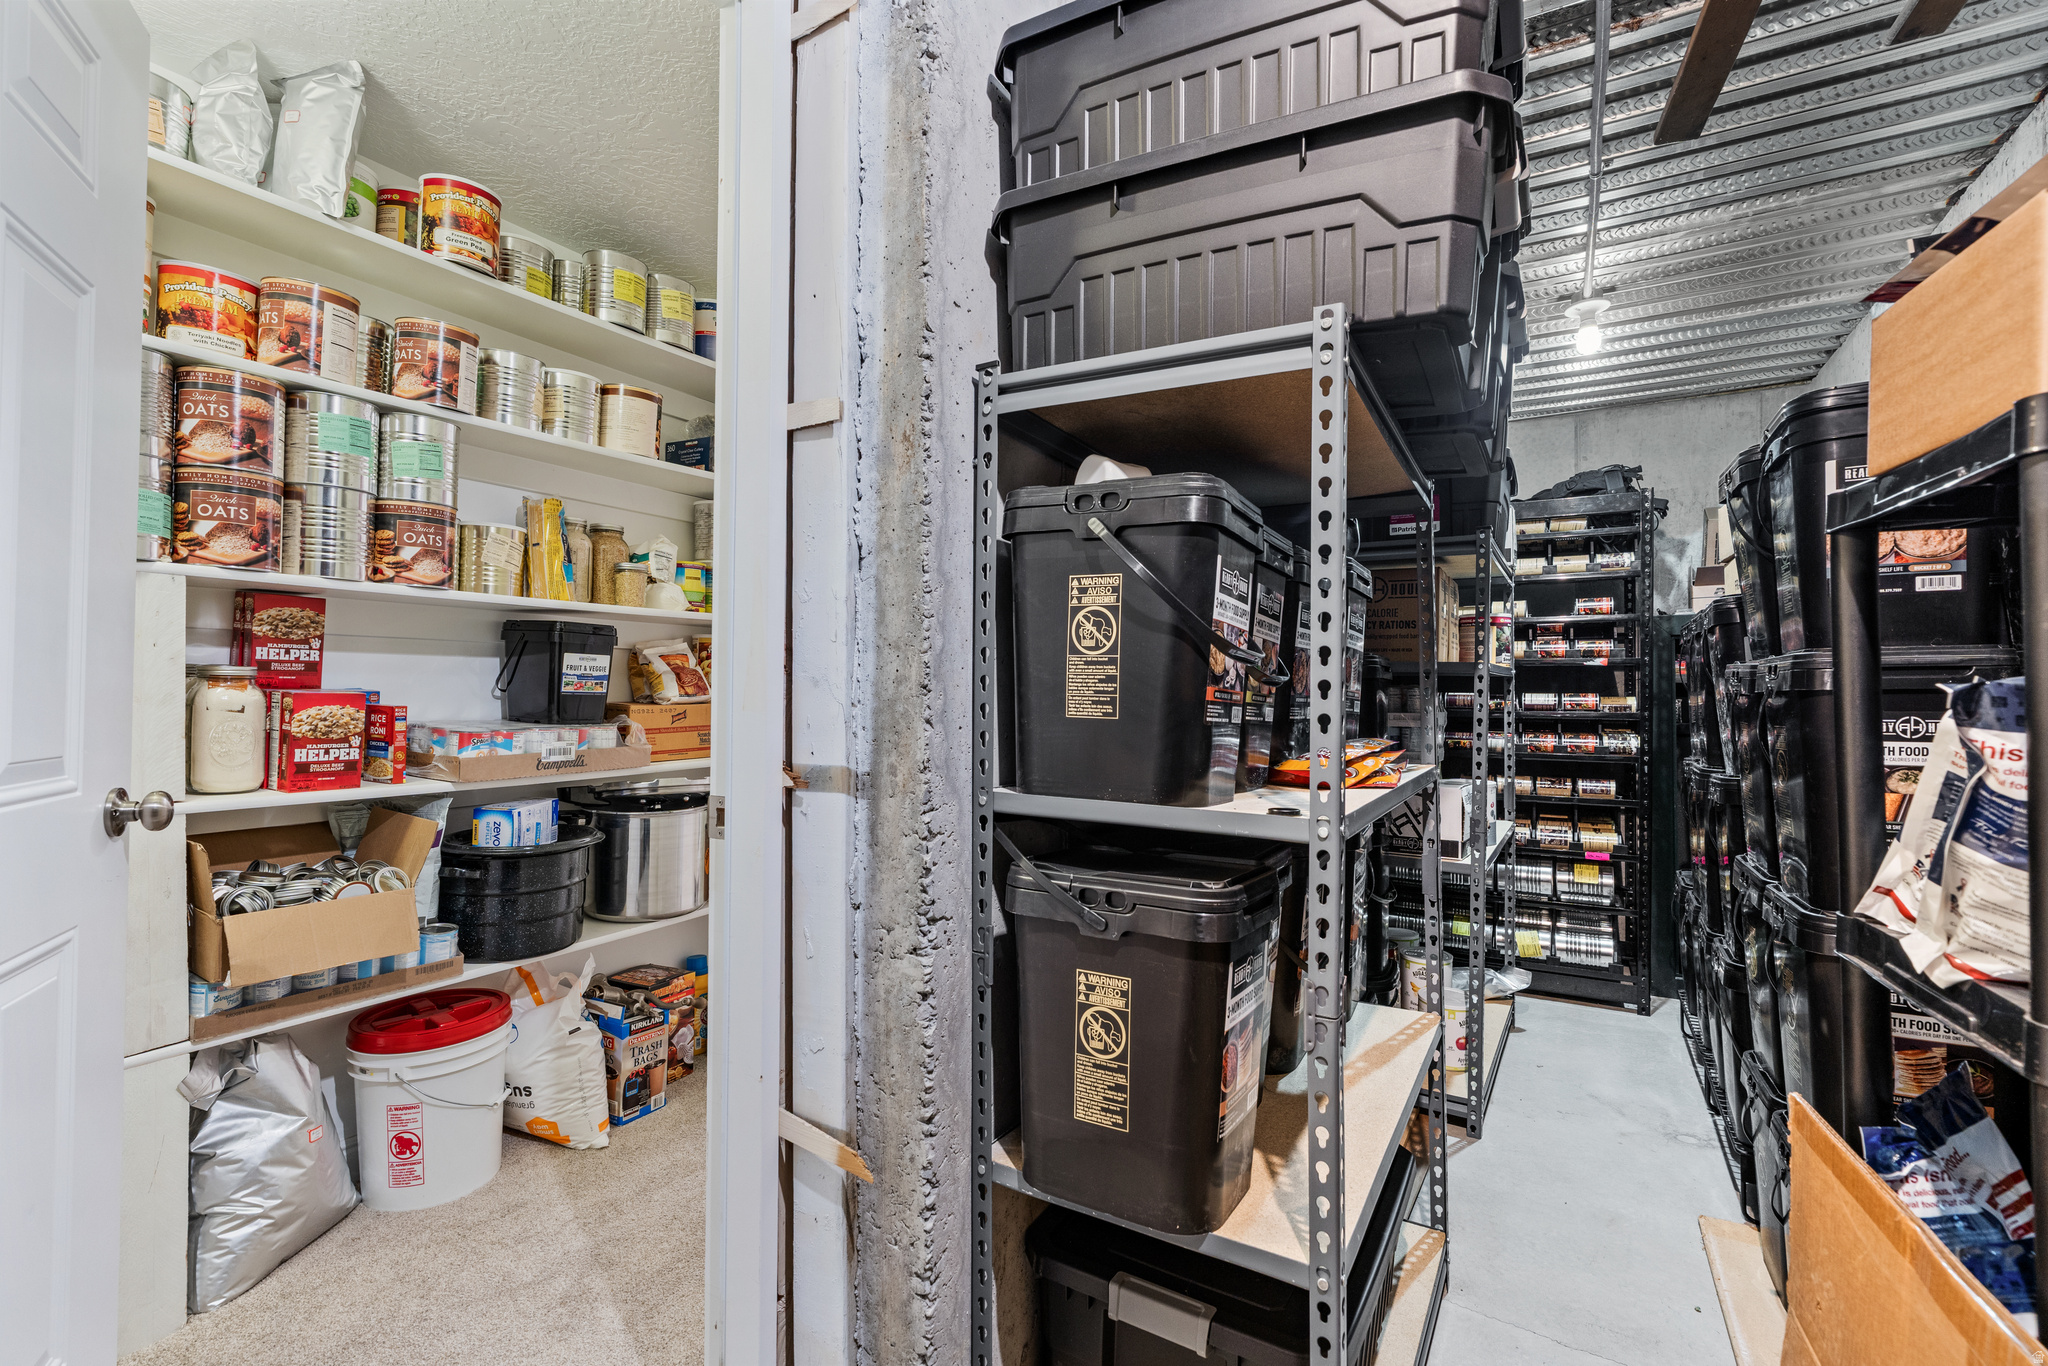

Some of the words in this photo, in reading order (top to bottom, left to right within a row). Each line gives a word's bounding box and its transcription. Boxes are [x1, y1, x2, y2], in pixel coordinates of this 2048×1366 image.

[430, 191, 475, 205] Provident
[476, 195, 498, 222] Pantry
[442, 201, 490, 225] PREMIUM
[446, 236, 468, 247] Green
[470, 242, 486, 253] Peas
[272, 282, 307, 291] STORAGE
[164, 281, 217, 295] Provident
[218, 288, 253, 312] Pantry
[176, 293, 238, 316] PREMIUM
[261, 302, 271, 310] uick
[260, 311, 279, 324] ATS
[187, 331, 215, 341] Teriyaki
[217, 337, 242, 348] Noodles
[397, 339, 414, 347] Quick
[210, 341, 237, 351] Chicken
[394, 348, 422, 360] OATS
[190, 391, 217, 401] Quick
[182, 402, 230, 418] OATS
[666, 444, 676, 453] 360
[1844, 467, 1868, 479] REA
[239, 477, 274, 488] STORAGE
[206, 493, 238, 504] Quick
[197, 503, 249, 521] OATS
[410, 524, 435, 533] Quick
[1398, 525, 1417, 533] Patrio
[403, 532, 443, 547] OATS
[1080, 576, 1120, 585] WARNING
[1087, 586, 1112, 595] AVISO
[1391, 582, 1418, 595] HOU
[1366, 607, 1399, 618] CALORIE
[1378, 620, 1417, 630] RATIONS
[255, 646, 320, 661] HELPER
[370, 713, 386, 723] RICE
[369, 726, 386, 735] RONI
[293, 747, 360, 762] HELPER
[1899, 746, 1930, 757] FOOD
[492, 821, 501, 847] zevo
[1087, 973, 1129, 989] WARNING
[1094, 985, 1121, 998] AVISO
[630, 1014, 664, 1031] KIRKLAND
[1909, 1019, 1941, 1033] FOOD
[628, 1027, 666, 1046] DRAWSTRING
[1899, 1029, 1922, 1037] CALORIES
[629, 1039, 663, 1059] TRASH
[633, 1051, 659, 1067] BAGS
[393, 1104, 420, 1112] WARNING
